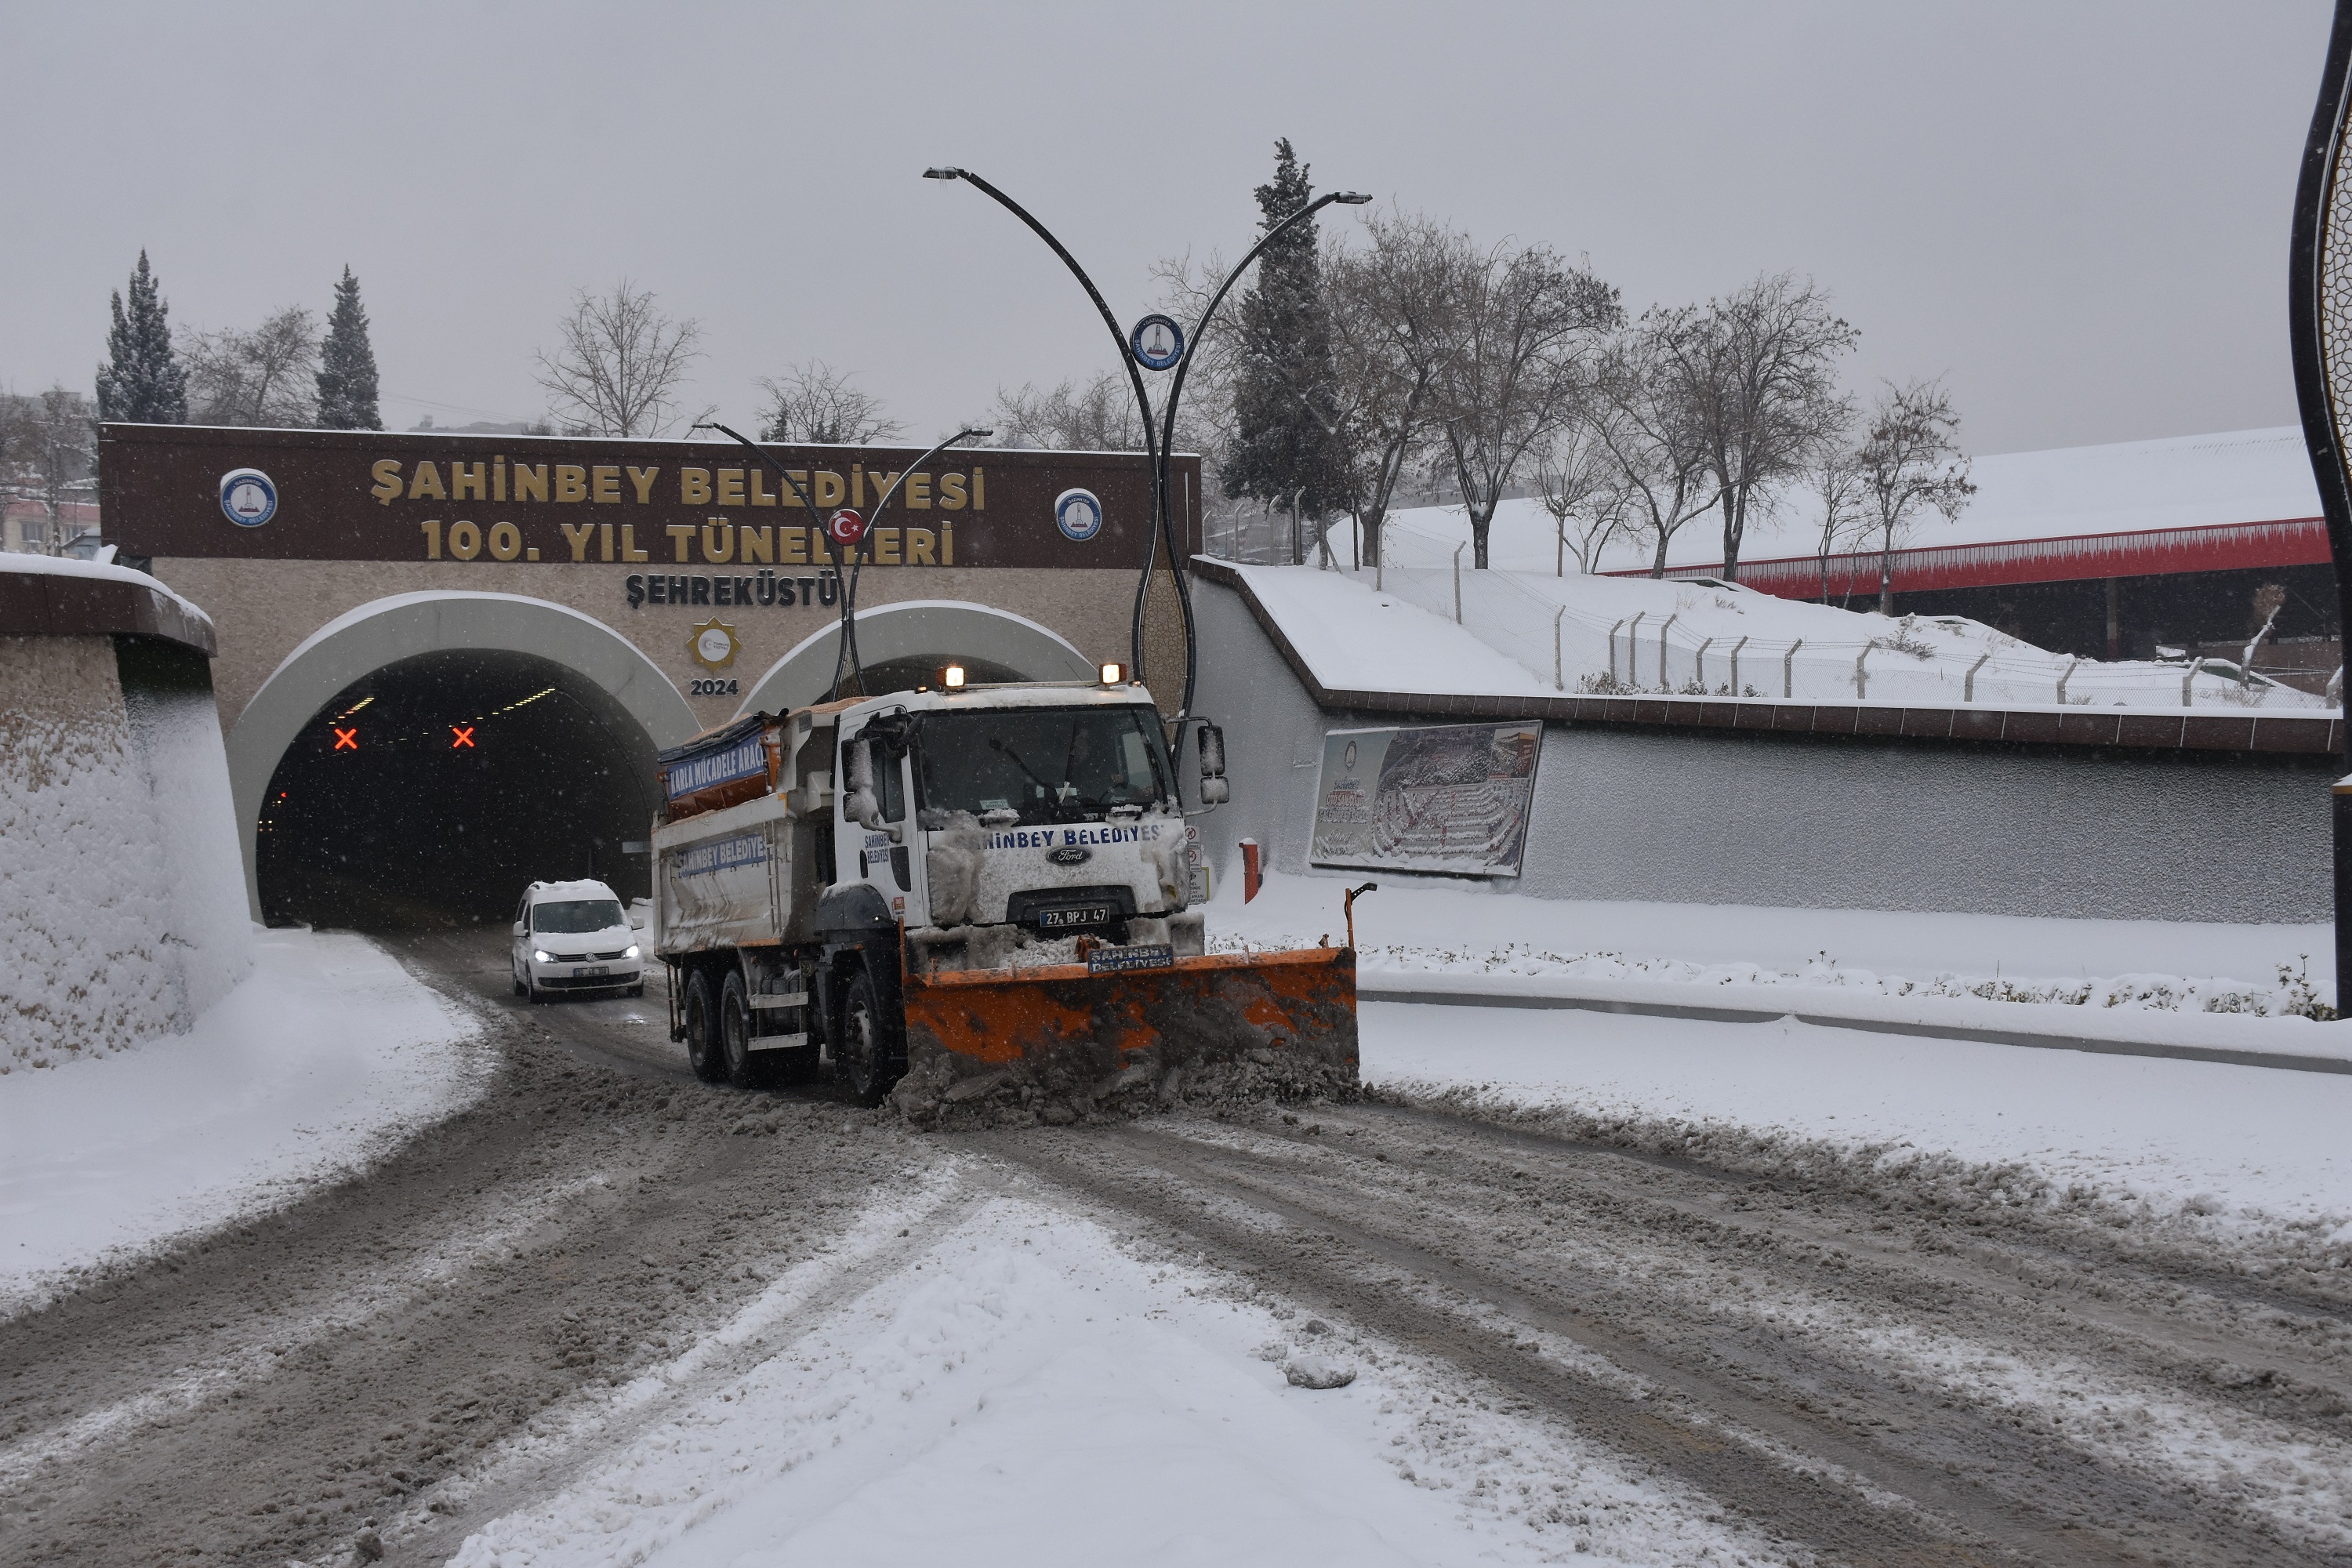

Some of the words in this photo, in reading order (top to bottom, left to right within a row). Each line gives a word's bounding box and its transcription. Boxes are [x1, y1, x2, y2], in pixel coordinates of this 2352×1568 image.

[371, 455, 659, 506] ŞAHİNBEY
[681, 463, 985, 510] BELEDİYESİ
[421, 520, 539, 561] 100.
[561, 524, 648, 561] YIL
[666, 517, 953, 565] TÜNELLERİ
[626, 568, 838, 609] ŞEHREKÜSTÜ
[690, 678, 739, 695] 2024
[670, 765, 694, 794] KARLA
[695, 751, 737, 786] MÜCADELE
[720, 836, 768, 865] BELEDİYE
[1058, 849, 1083, 862] Ford
[1046, 913, 1059, 924] 27
[1066, 911, 1087, 924] BPJ
[1094, 909, 1106, 920] 47
